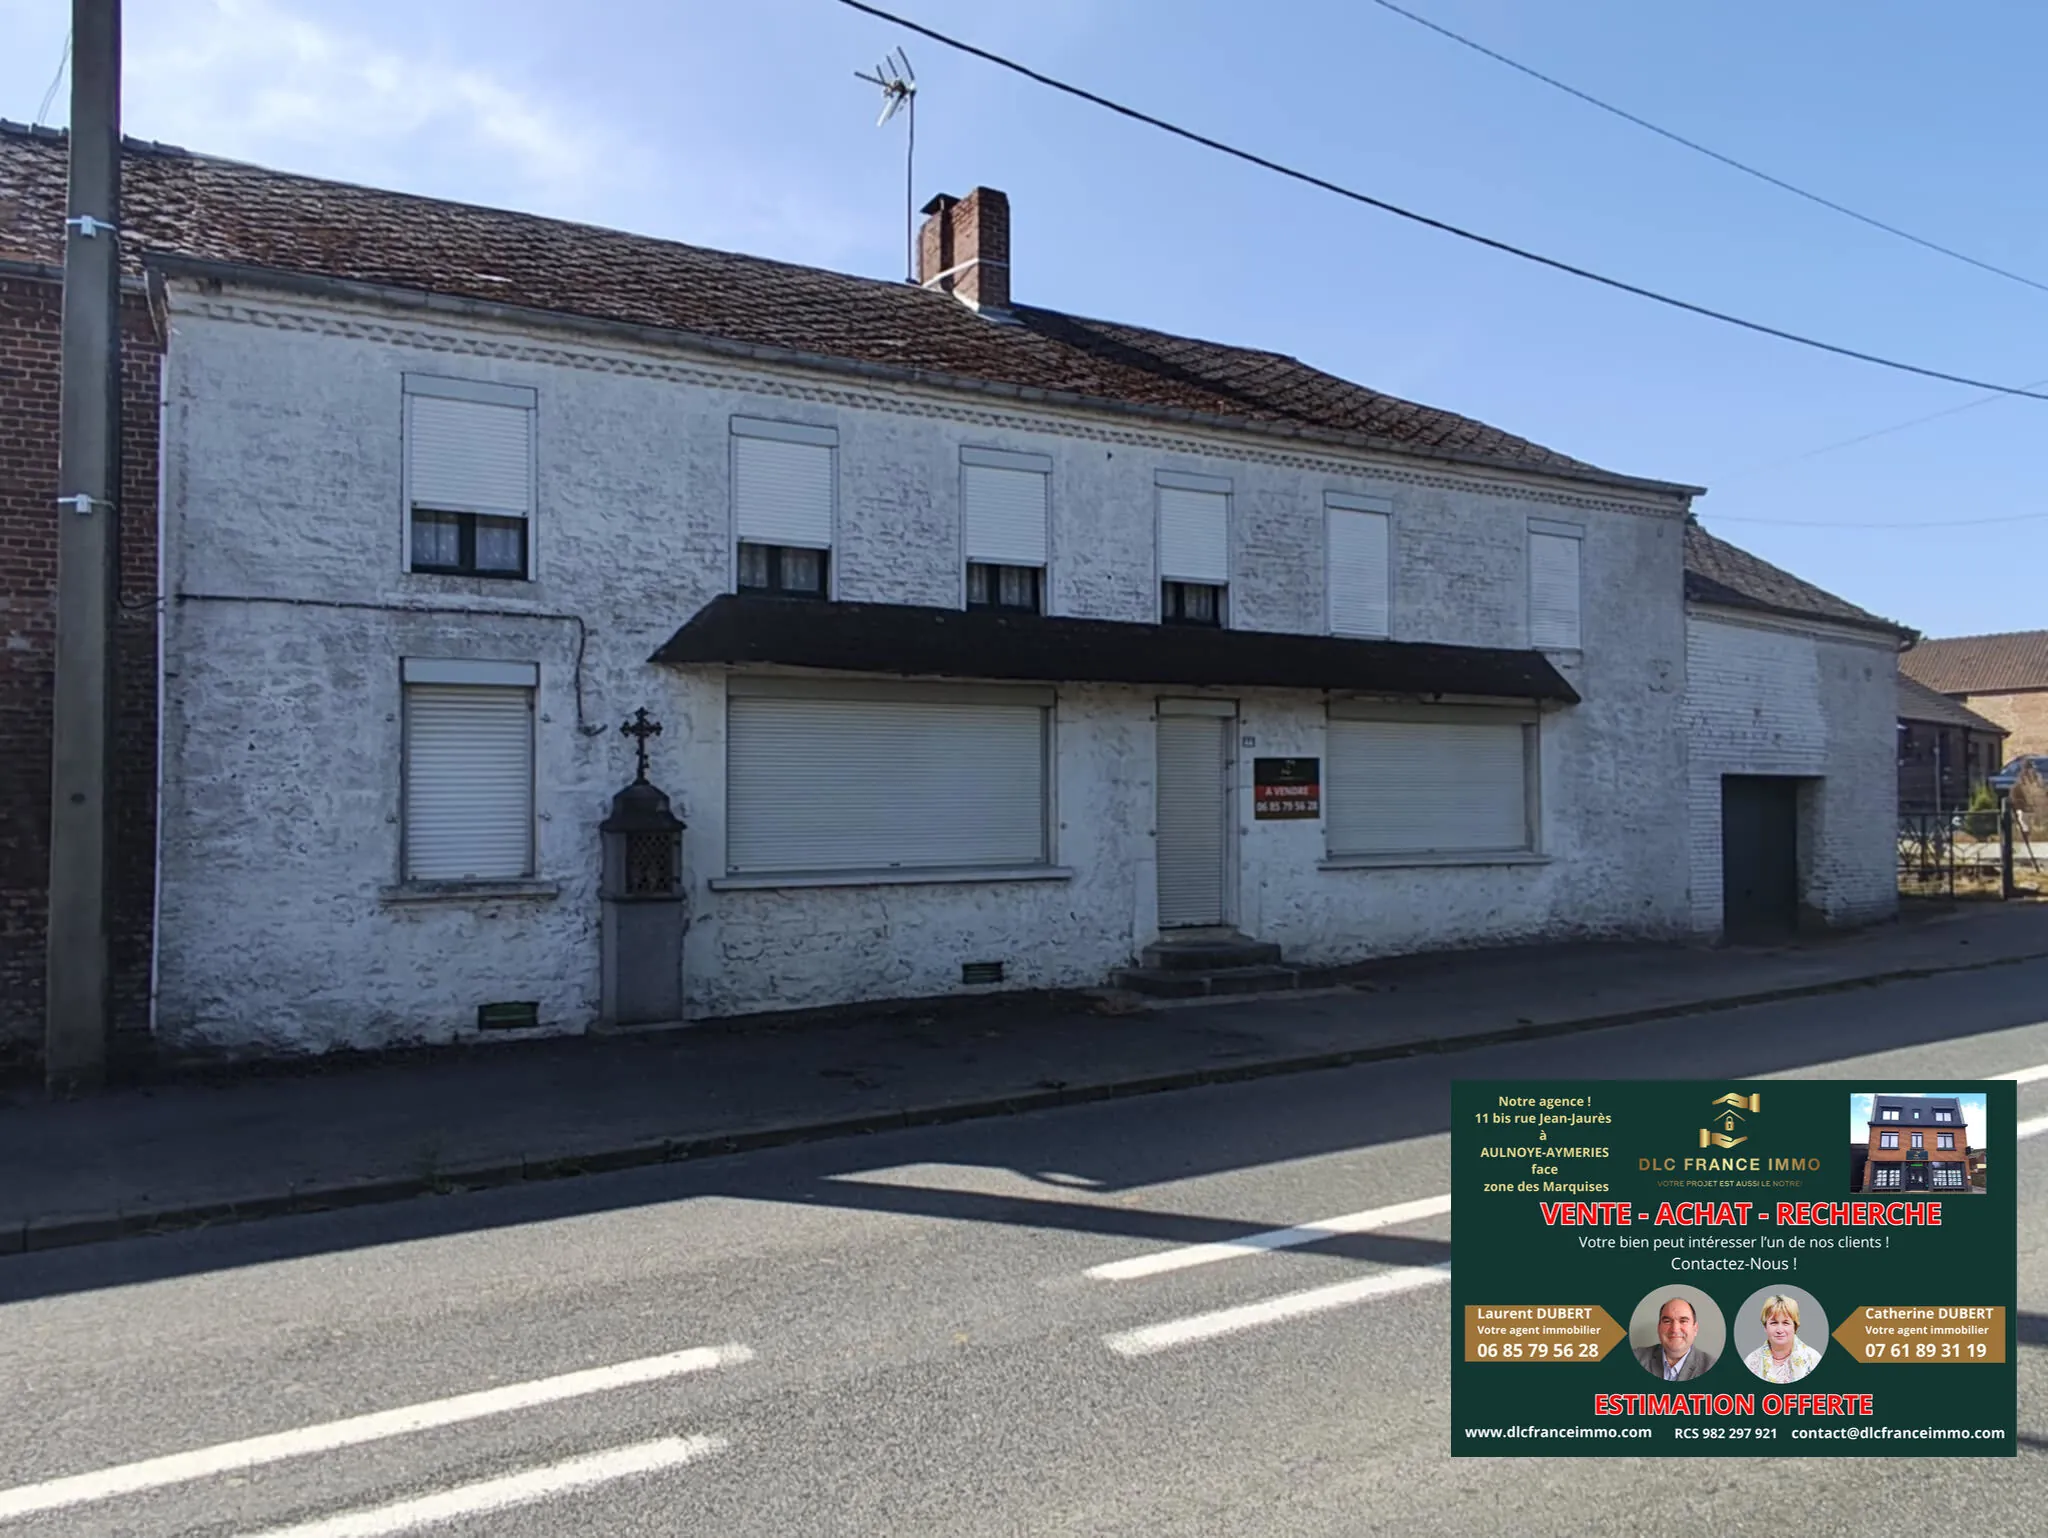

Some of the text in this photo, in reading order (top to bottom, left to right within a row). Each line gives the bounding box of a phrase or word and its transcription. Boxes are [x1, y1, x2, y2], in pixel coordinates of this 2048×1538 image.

[1265, 786, 1309, 796] A VENDRE
[1256, 800, 1318, 812] 06 85 79 56 28
